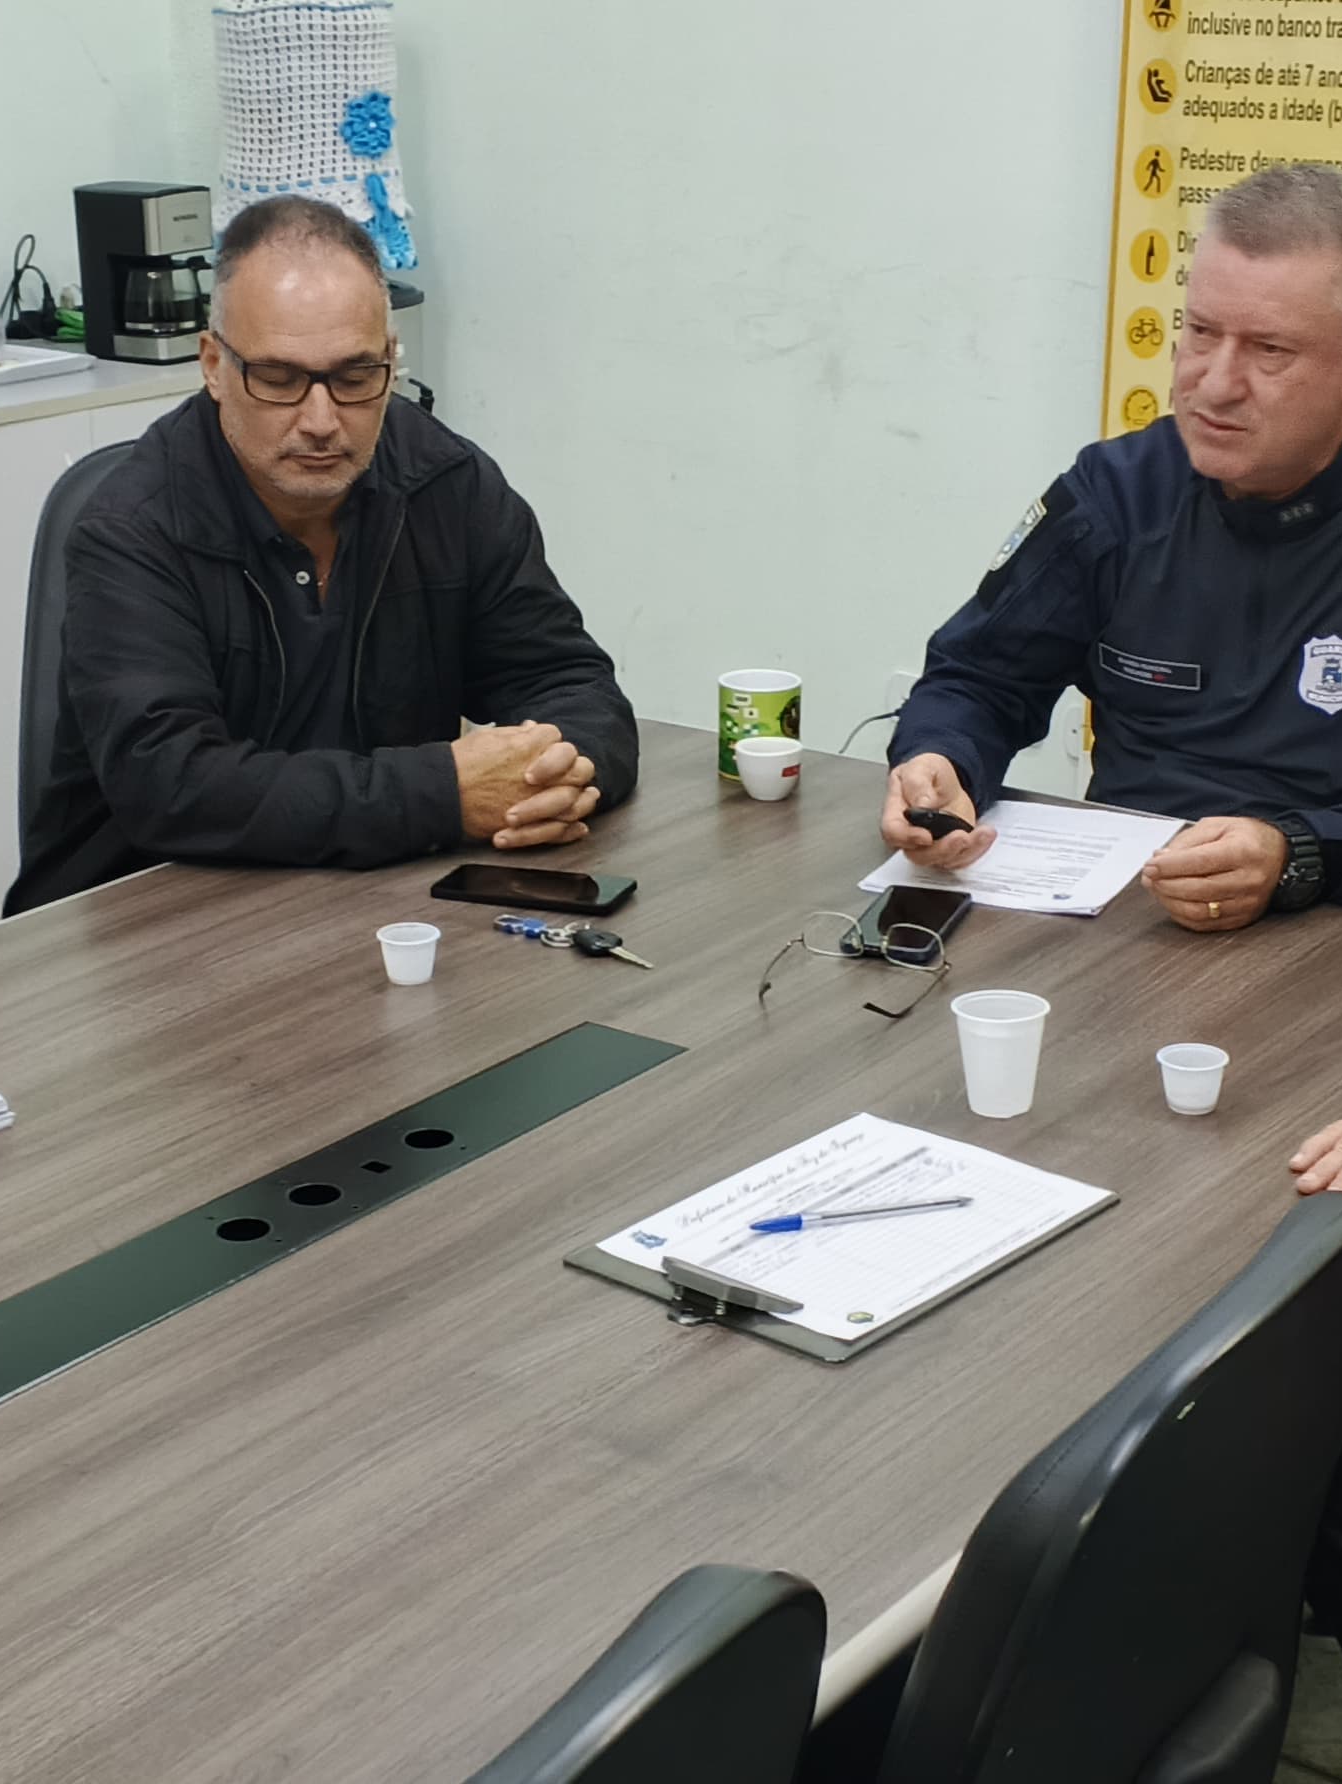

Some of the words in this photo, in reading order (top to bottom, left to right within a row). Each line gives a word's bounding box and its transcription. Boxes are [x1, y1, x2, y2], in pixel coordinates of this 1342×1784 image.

[1187, 12, 1251, 35] inclusive
[1255, 18, 1274, 36] no
[1277, 14, 1322, 38] banco
[1185, 59, 1250, 90] Crianças
[1256, 62, 1274, 85] de
[1278, 63, 1300, 86] até
[1304, 64, 1314, 86] 7
[1183, 97, 1264, 125] adequados
[1268, 101, 1278, 120] a
[1282, 97, 1324, 122] idade
[1179, 147, 1246, 172] Pedestre
